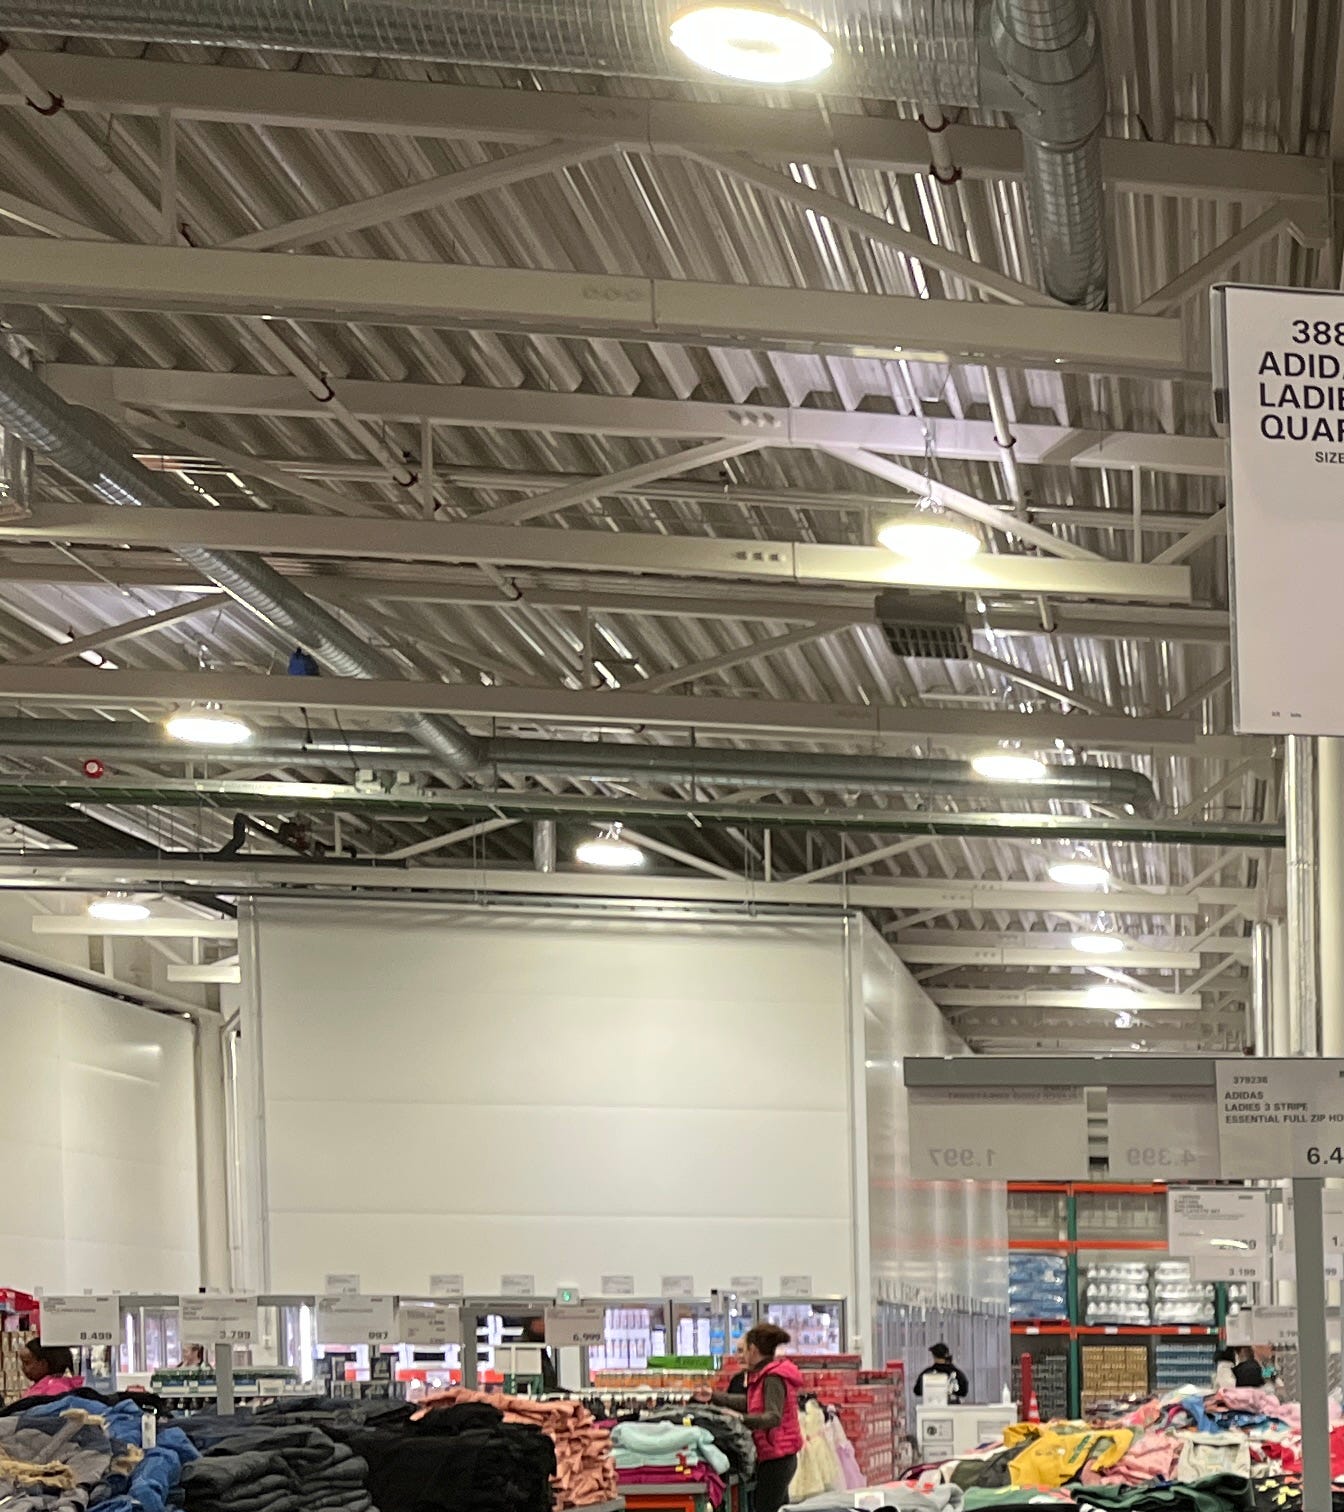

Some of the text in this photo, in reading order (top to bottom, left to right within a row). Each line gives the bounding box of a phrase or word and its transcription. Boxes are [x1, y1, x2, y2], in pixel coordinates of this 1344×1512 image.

[1224, 1090, 1264, 1100] ADIDAS
[1224, 1102, 1308, 1112] LADIES 3 STRIPE
[1225, 1114, 1280, 1124] ESSENTIAL
[1282, 1114, 1308, 1124] FULL
[1310, 1114, 1326, 1124] ZIP
